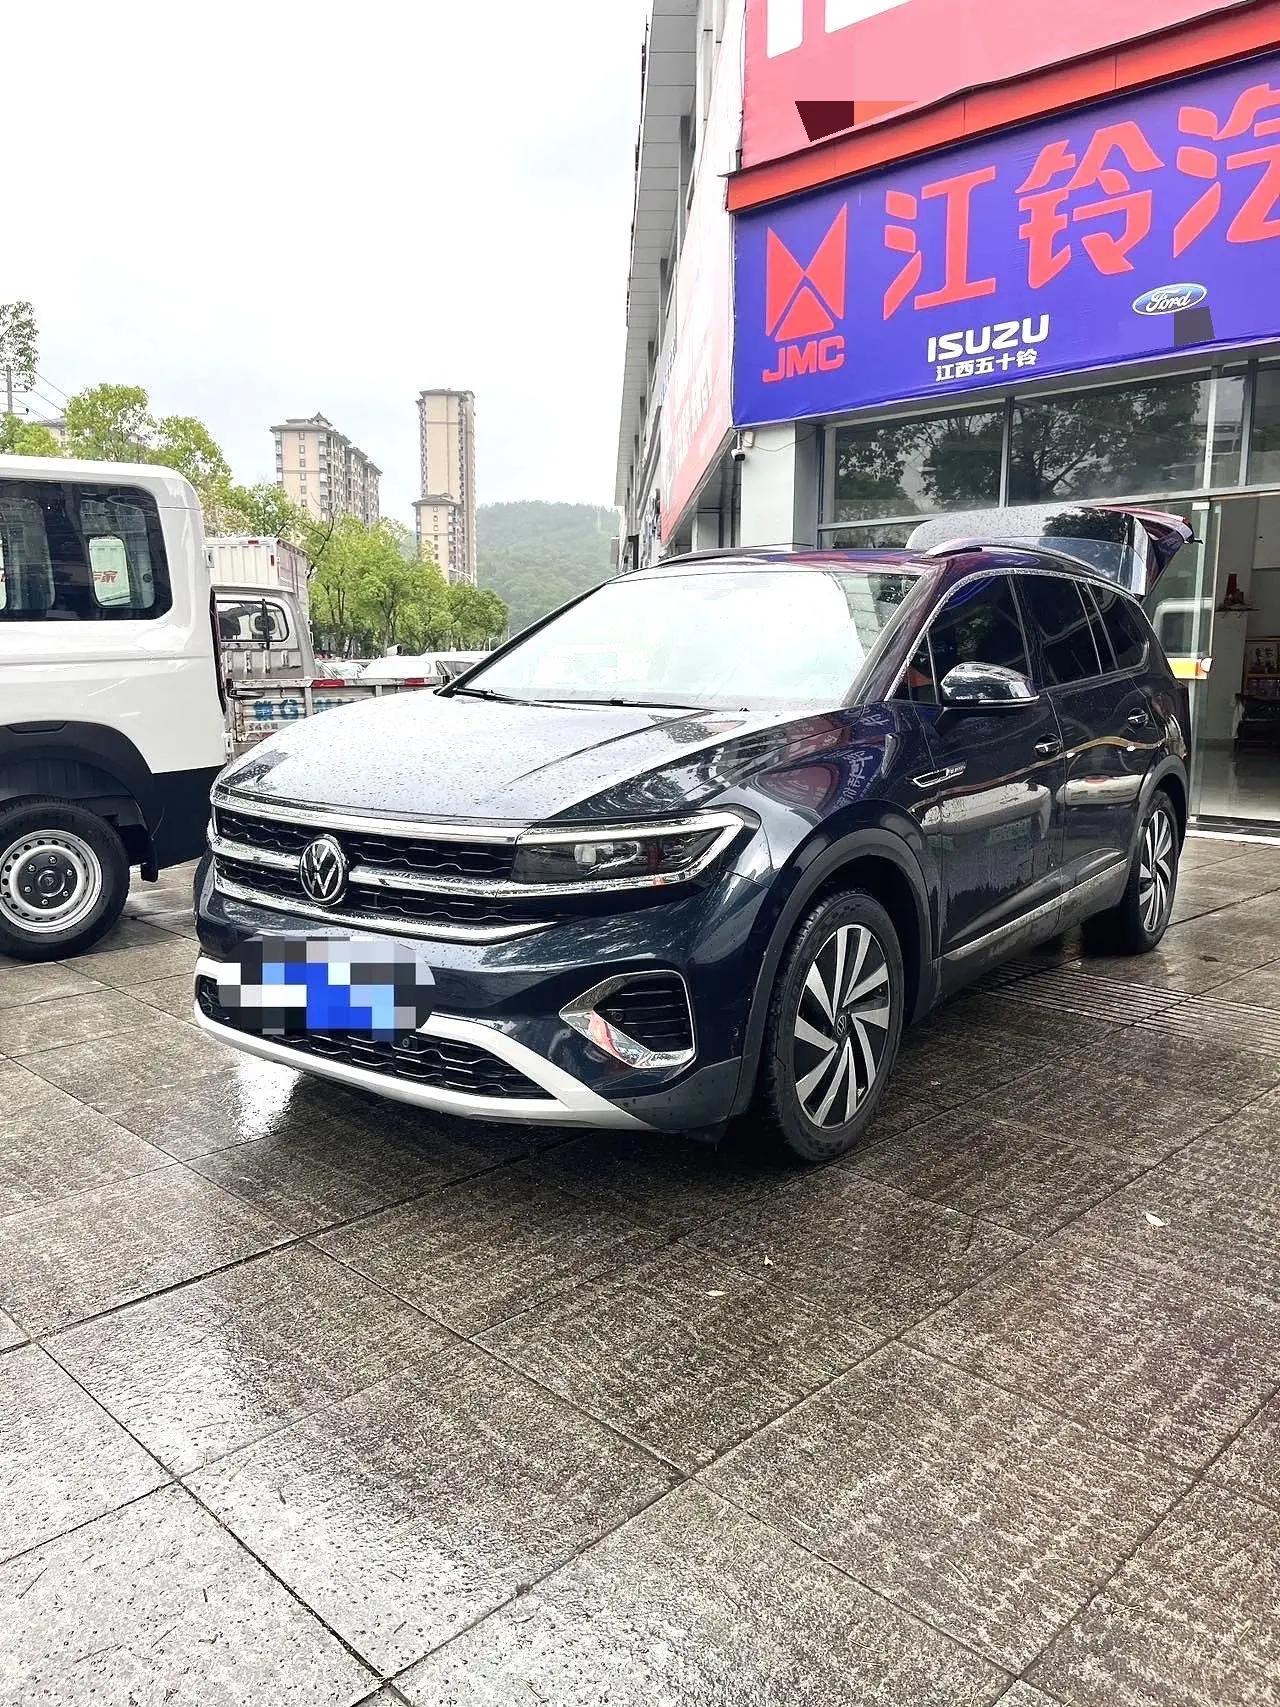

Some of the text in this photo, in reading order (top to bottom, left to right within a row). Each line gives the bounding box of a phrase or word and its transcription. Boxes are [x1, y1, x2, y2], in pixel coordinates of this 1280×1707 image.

[1145, 288, 1194, 313] Ford
[762, 335, 845, 383] JMC
[927, 314, 1050, 363] ISUZU
[935, 348, 1038, 382] 江西五十铃
